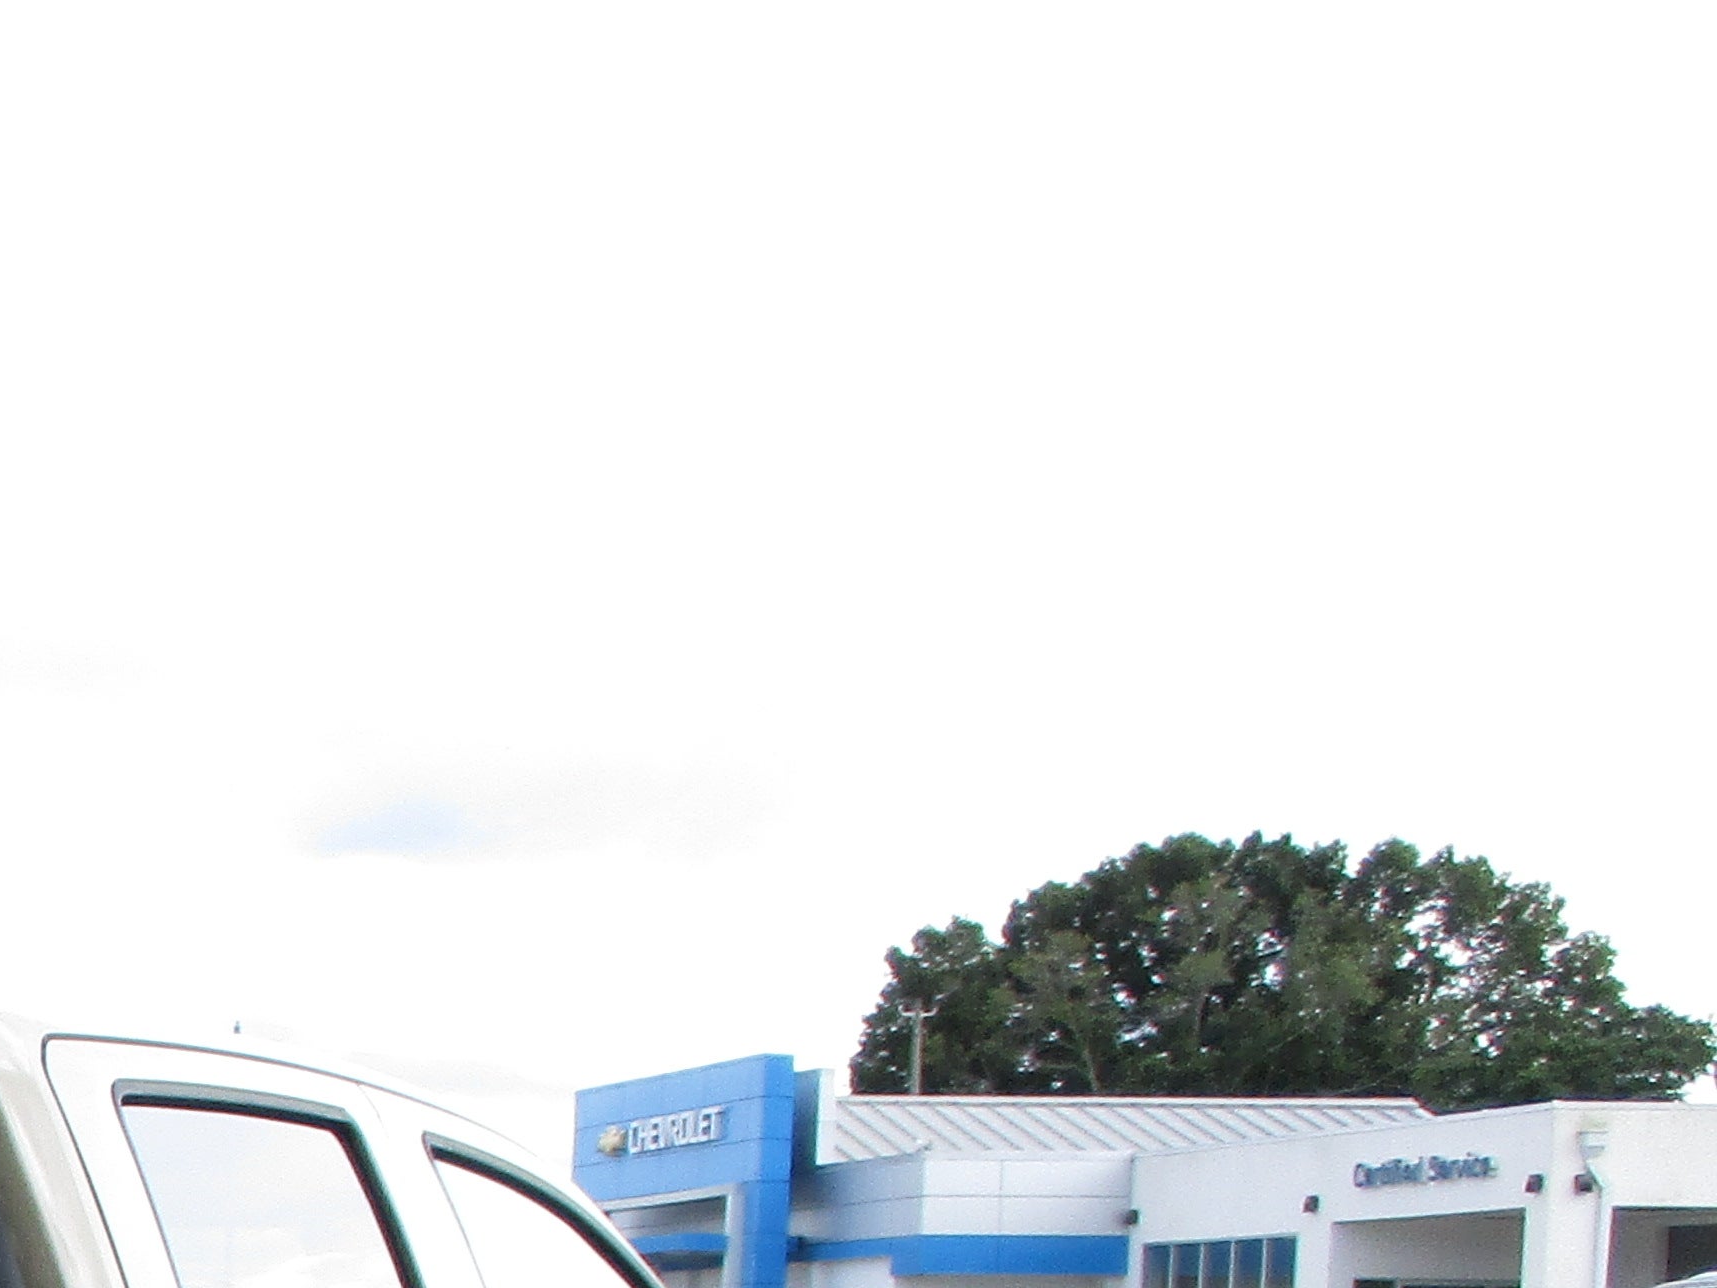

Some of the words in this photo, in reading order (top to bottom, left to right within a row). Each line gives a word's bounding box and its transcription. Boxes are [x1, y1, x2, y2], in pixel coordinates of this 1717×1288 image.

[628, 1104, 726, 1154] CHEVROLET
[1353, 1156, 1424, 1188] Certified
[1427, 1152, 1497, 1181] Service
